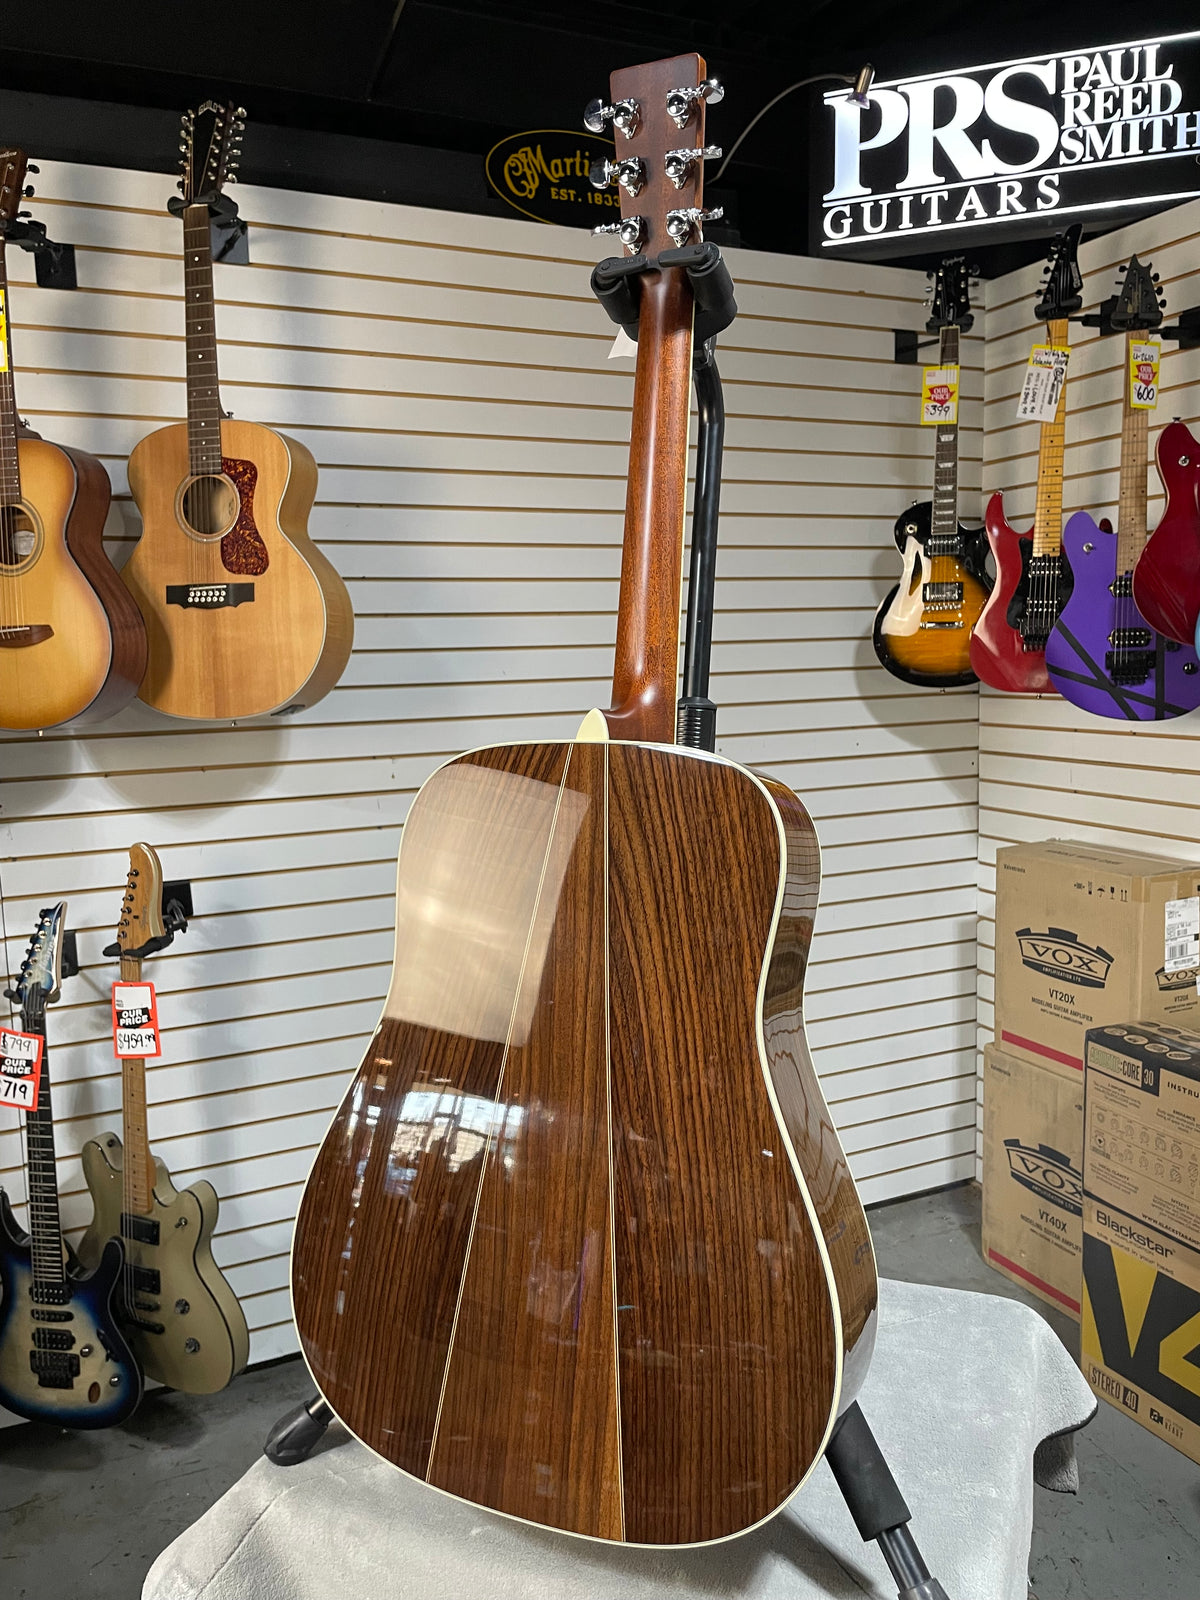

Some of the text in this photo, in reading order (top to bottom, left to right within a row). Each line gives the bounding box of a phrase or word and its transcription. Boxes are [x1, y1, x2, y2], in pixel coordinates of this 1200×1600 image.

[1061, 44, 1174, 92] PAUL
[1061, 79, 1183, 129] REED
[823, 59, 1060, 202] PRS
[1059, 111, 1200, 166] SMITH
[550, 187, 621, 208] EST. 1833
[823, 173, 1060, 240] GUITARS
[933, 387, 949, 396] OUR
[1026, 941, 1098, 975] VOX
[1163, 968, 1200, 983] VOX
[1048, 987, 1076, 1006] VT20X
[119, 1014, 149, 1027] PRICE
[122, 1009, 143, 1019] OUR
[1, 1064, 32, 1075] PRICE
[4, 1058, 27, 1067] OUR
[1015, 1153, 1083, 1202] VOX
[1038, 1207, 1067, 1234] VT40X
[1096, 1209, 1174, 1258] Blackstar
[1091, 1366, 1137, 1410] STEREO 40
